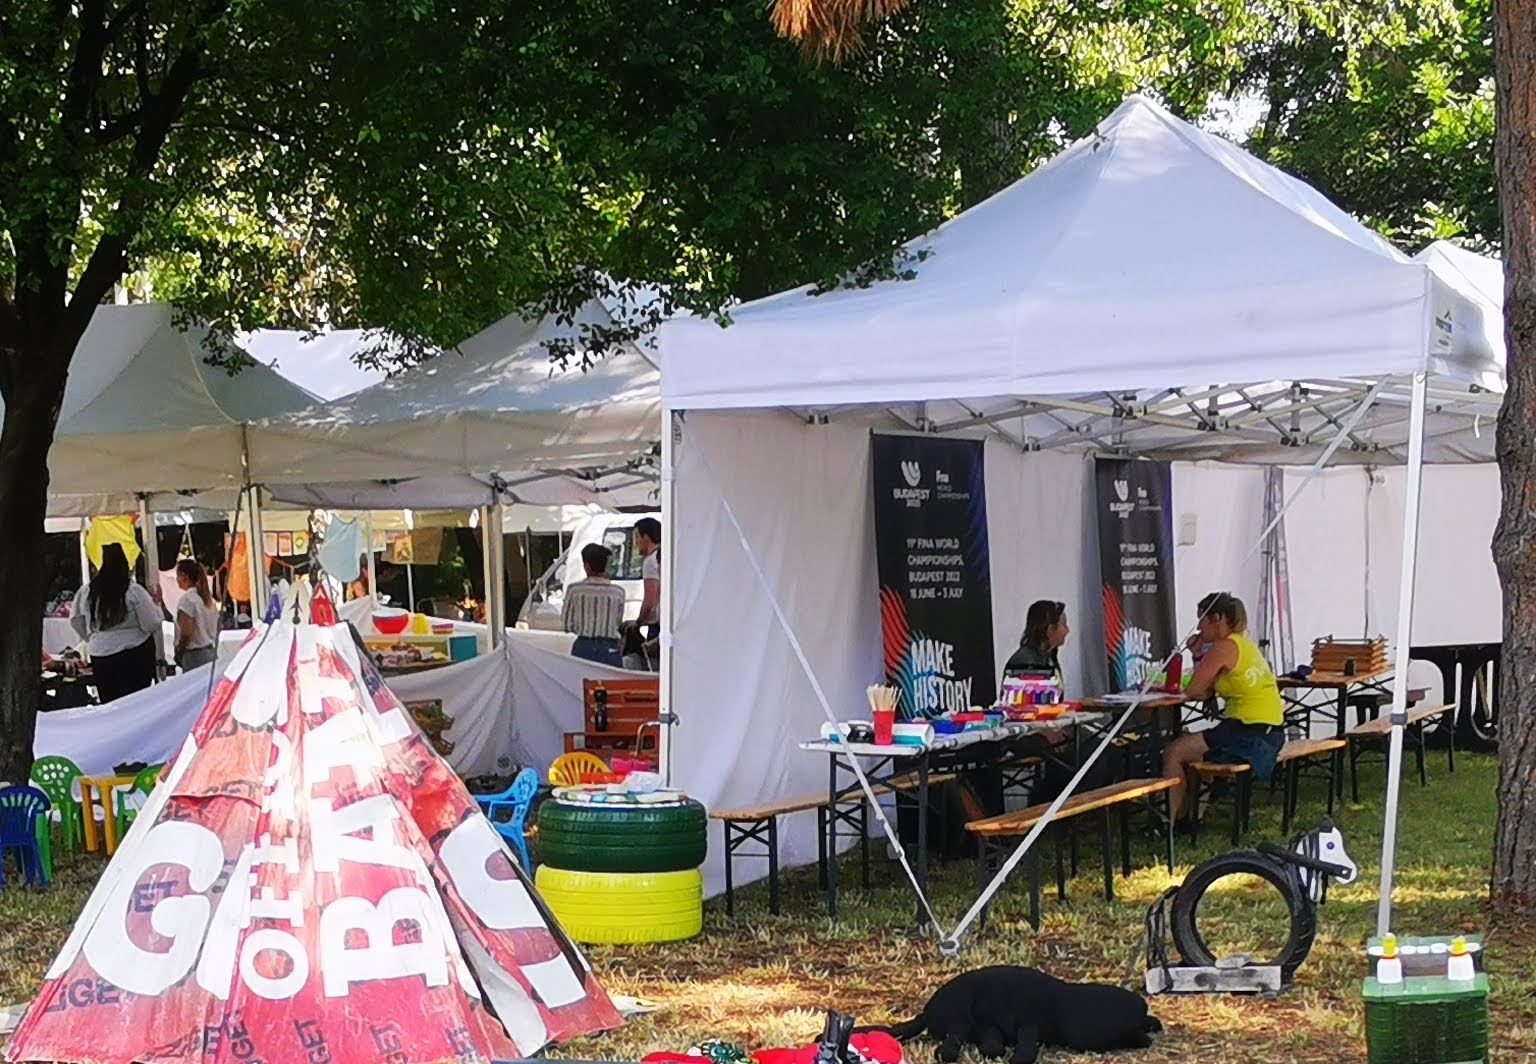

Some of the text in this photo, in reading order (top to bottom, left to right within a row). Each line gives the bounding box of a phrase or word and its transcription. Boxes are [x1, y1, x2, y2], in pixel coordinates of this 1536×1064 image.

[911, 638, 955, 677] MAKE
[1123, 626, 1152, 658] MAKE
[913, 675, 972, 713] HISTORY
